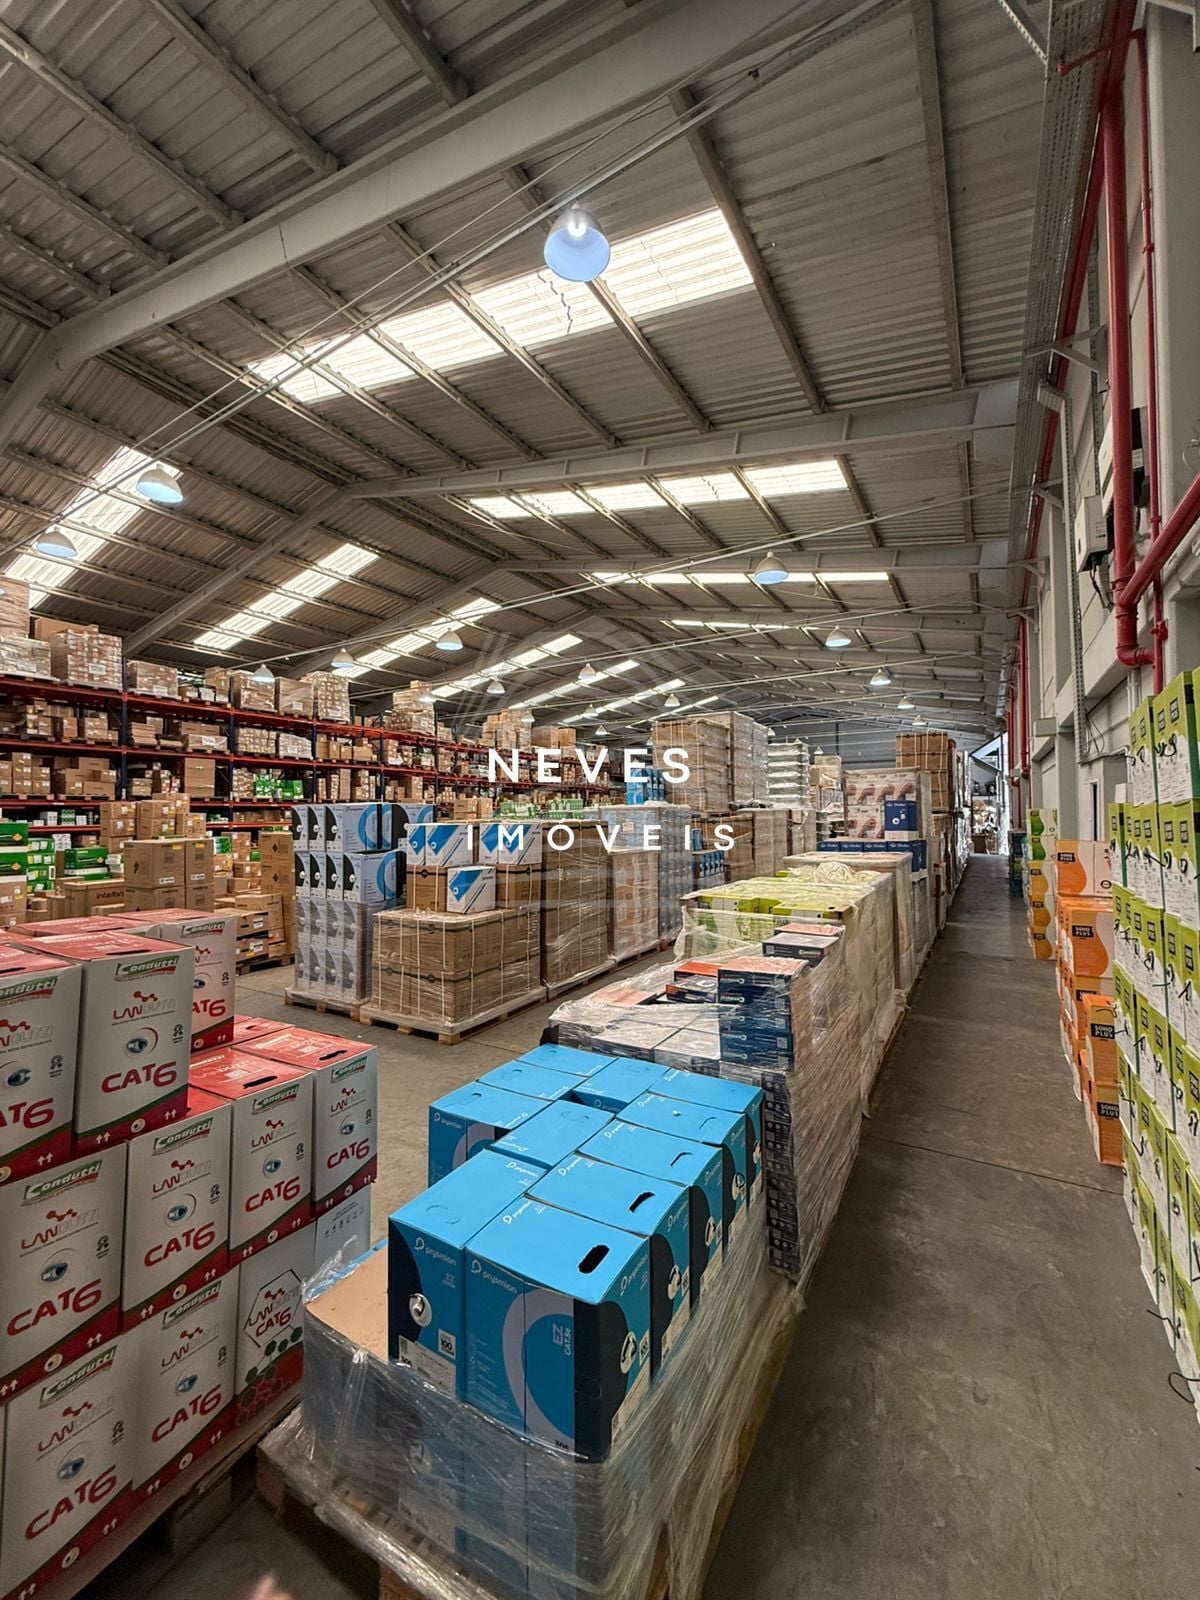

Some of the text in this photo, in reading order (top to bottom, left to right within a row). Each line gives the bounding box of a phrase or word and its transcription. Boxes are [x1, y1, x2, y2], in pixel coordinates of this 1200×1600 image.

[117, 957, 178, 976] Condutti
[192, 998, 226, 1017] AT6
[1094, 1030, 1114, 1038] PLUS
[101, 1060, 177, 1093] CAT6
[326, 1137, 369, 1169] CAT6
[25, 1160, 101, 1200] Condutti
[244, 1176, 301, 1212] CAT6
[144, 1221, 215, 1267] CAT6
[7, 1278, 102, 1336] CAT6
[256, 1306, 291, 1337] CAT6
[552, 1322, 563, 1346] EZ
[152, 1383, 222, 1443] CAT6
[25, 1463, 117, 1540] CAT6
